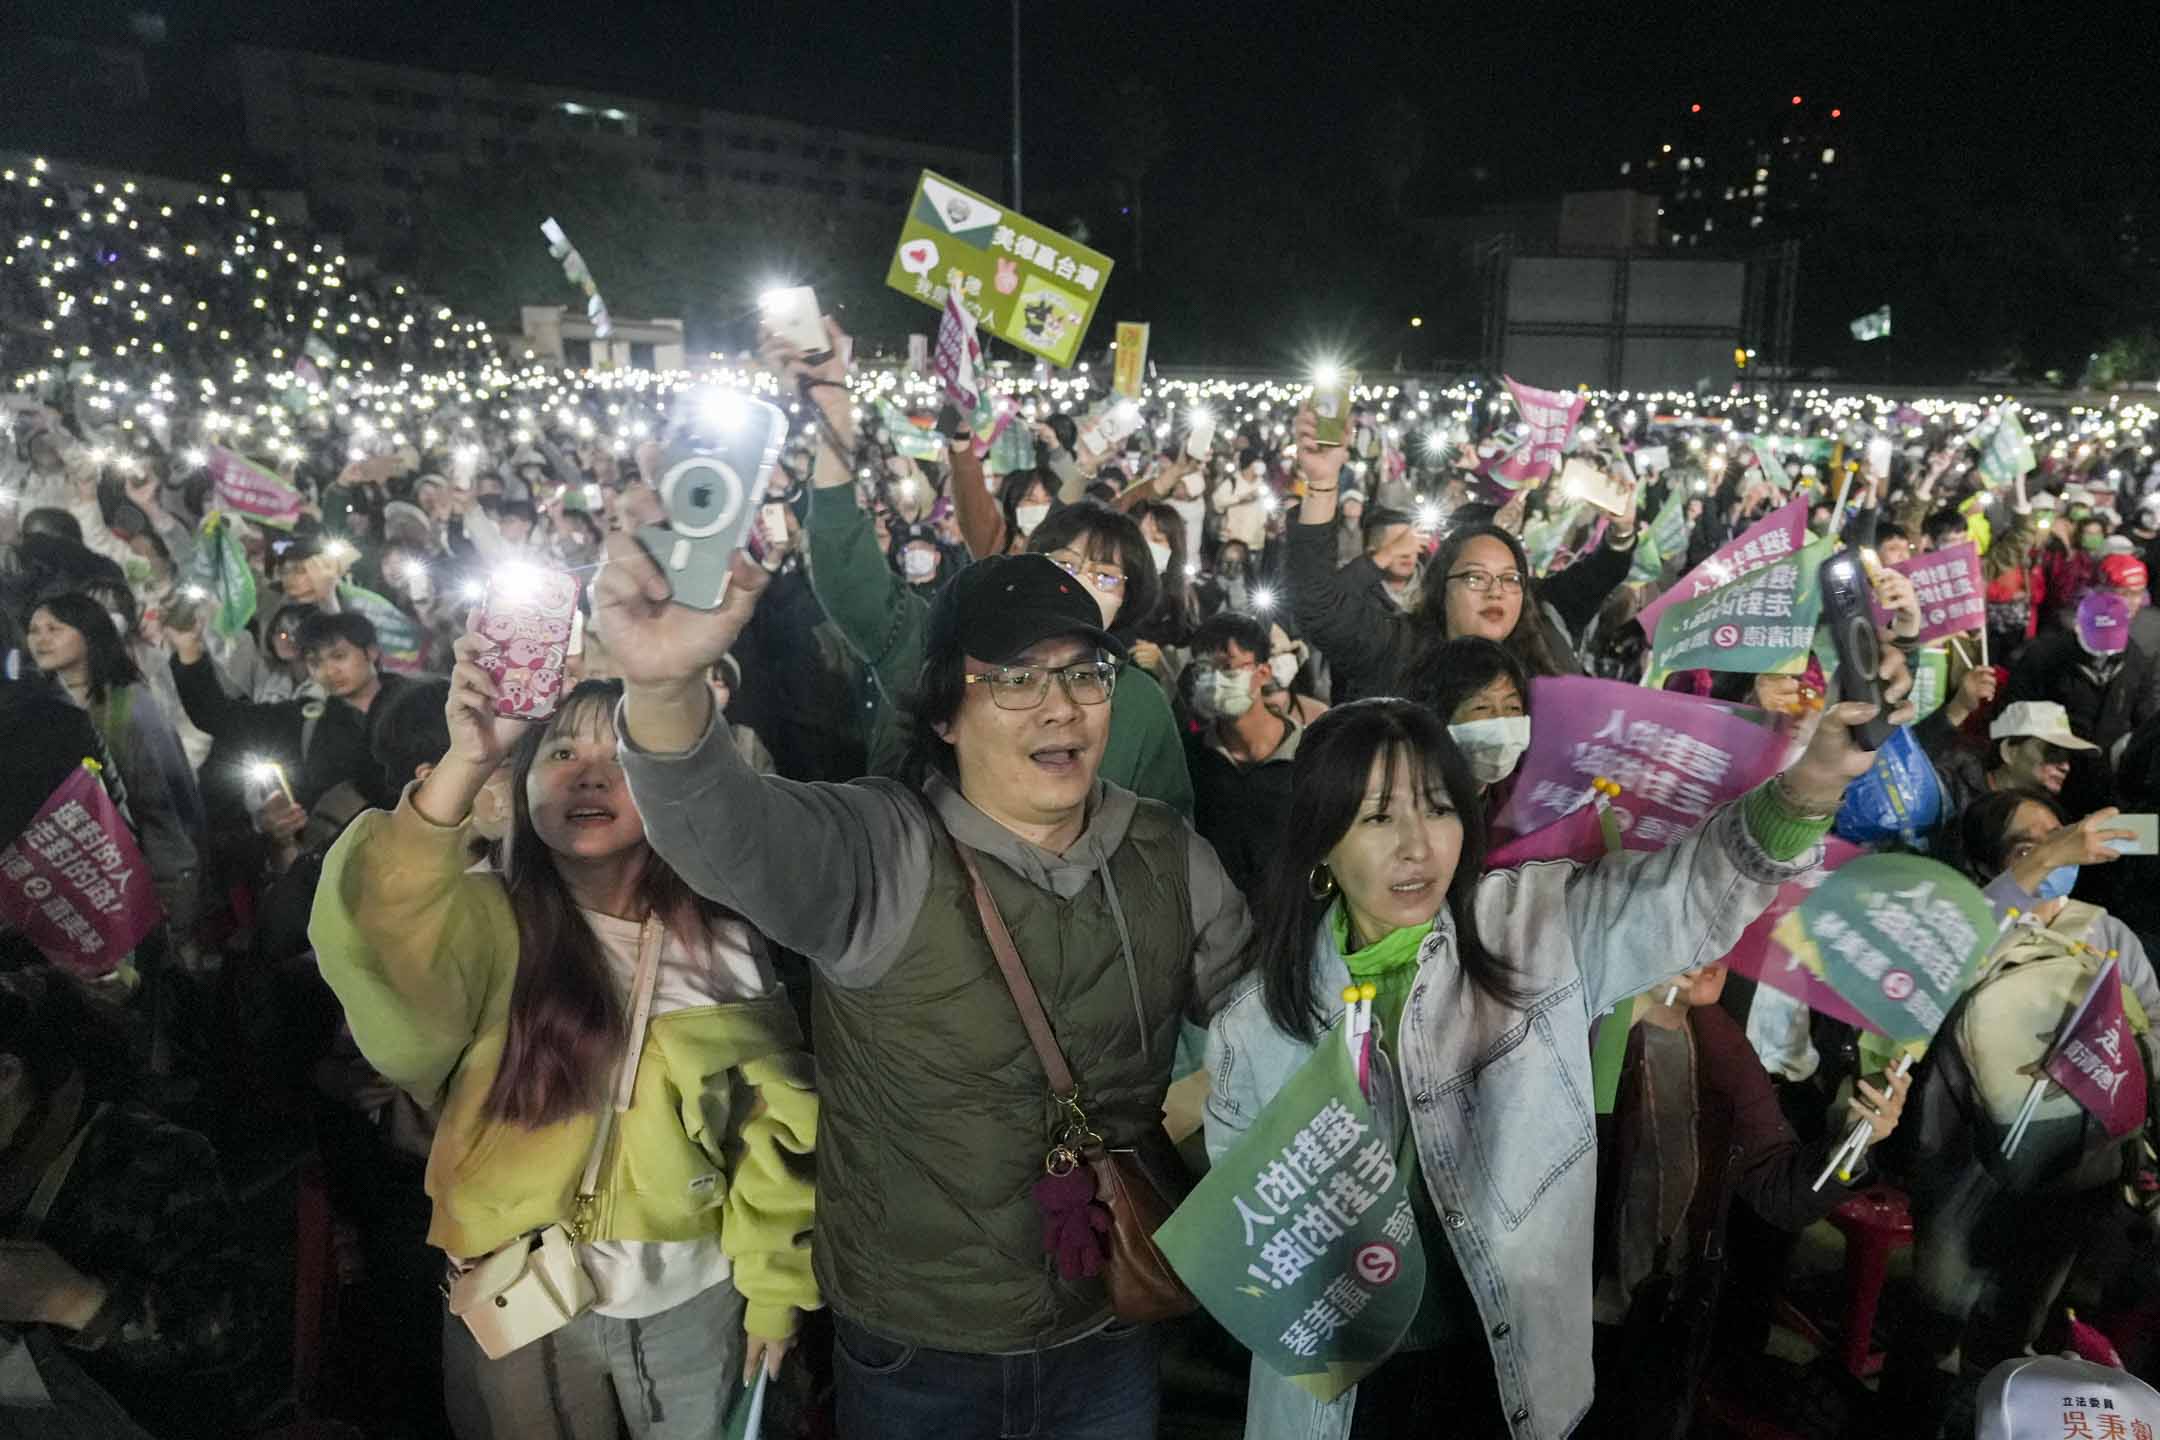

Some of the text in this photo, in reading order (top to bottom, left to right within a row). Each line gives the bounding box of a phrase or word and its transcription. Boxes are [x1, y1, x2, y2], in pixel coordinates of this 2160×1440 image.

[22, 821, 124, 914] 走對的路!
[51, 800, 133, 894] 選對的人
[2064, 1397, 2114, 1410] 立法委員
